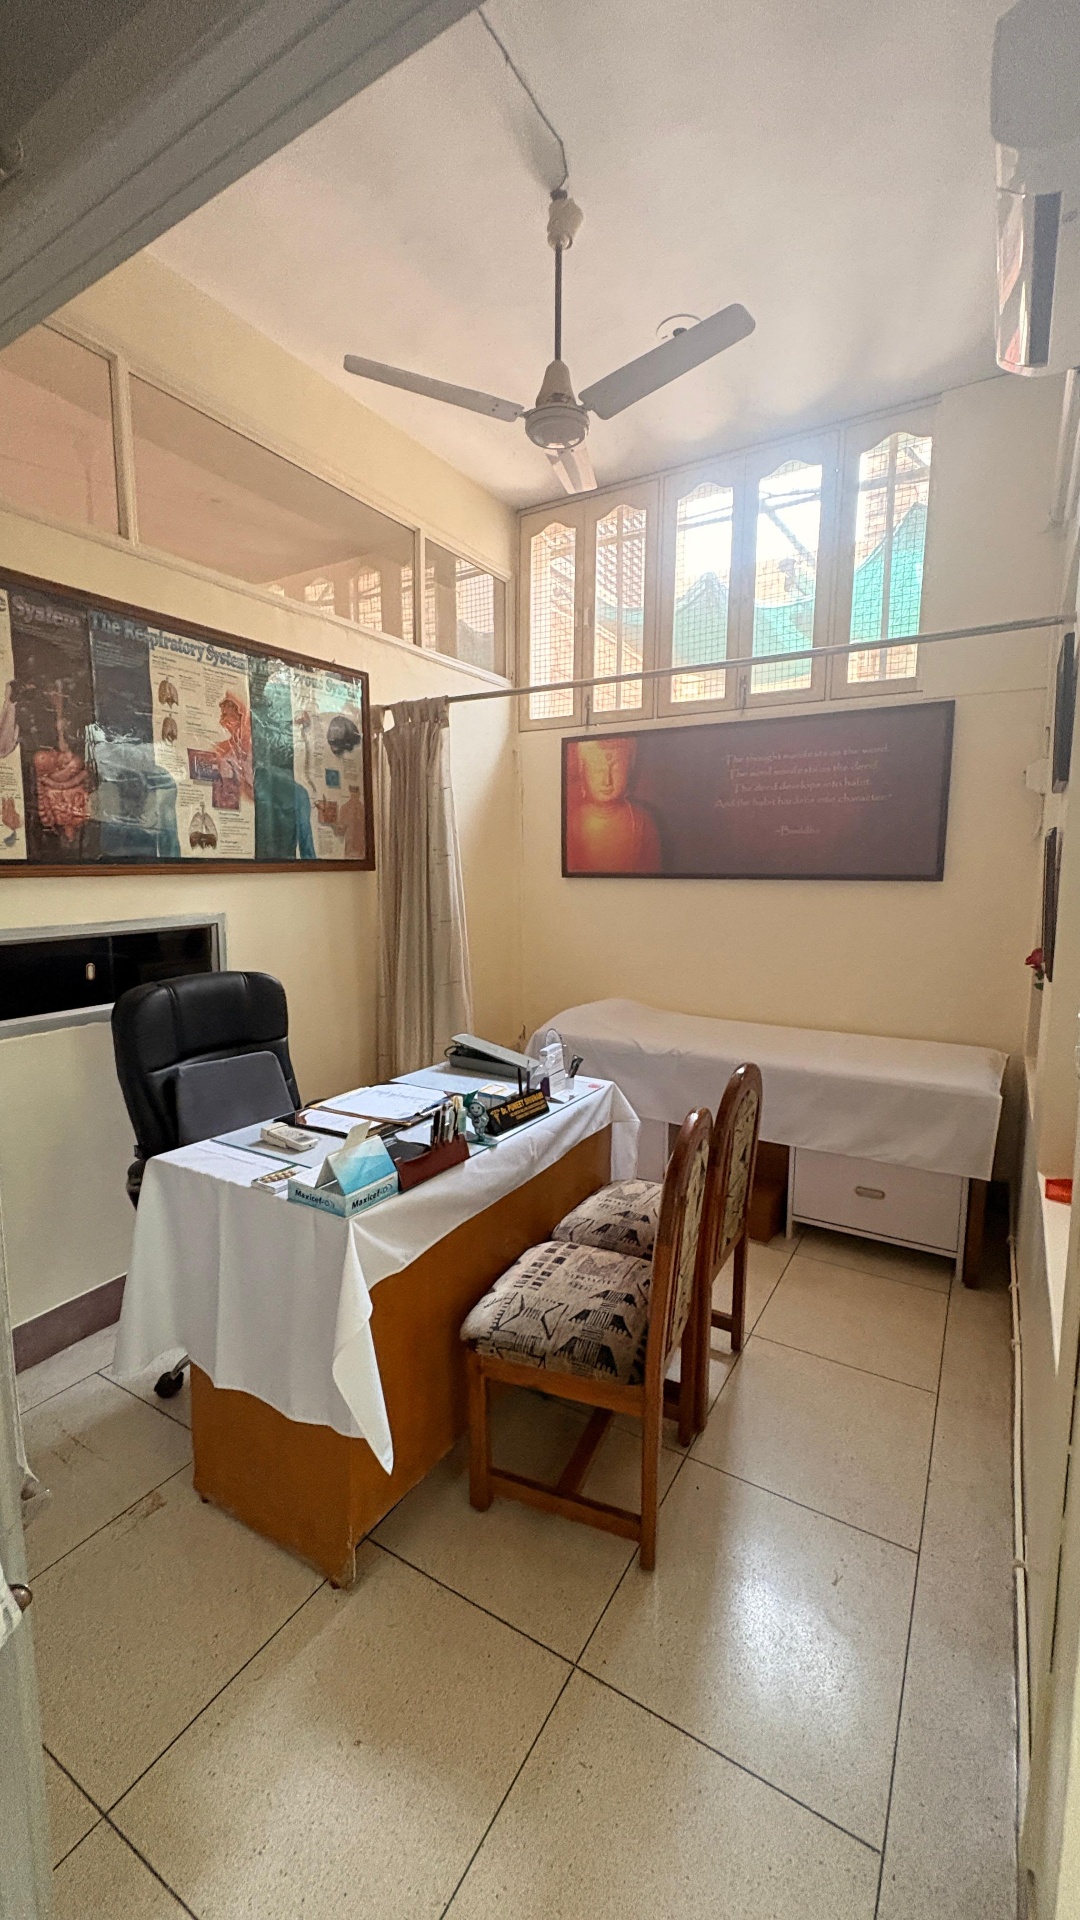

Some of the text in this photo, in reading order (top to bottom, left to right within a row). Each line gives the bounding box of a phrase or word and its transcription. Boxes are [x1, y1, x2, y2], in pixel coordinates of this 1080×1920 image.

[88, 609, 121, 635] The
[124, 619, 205, 662] Respiratory
[205, 643, 246, 670] System
[746, 750, 781, 764] thought
[843, 745, 860, 755] the
[728, 768, 748, 779] The
[833, 761, 848, 772] the
[732, 783, 752, 795] The
[779, 778, 821, 792] develops
